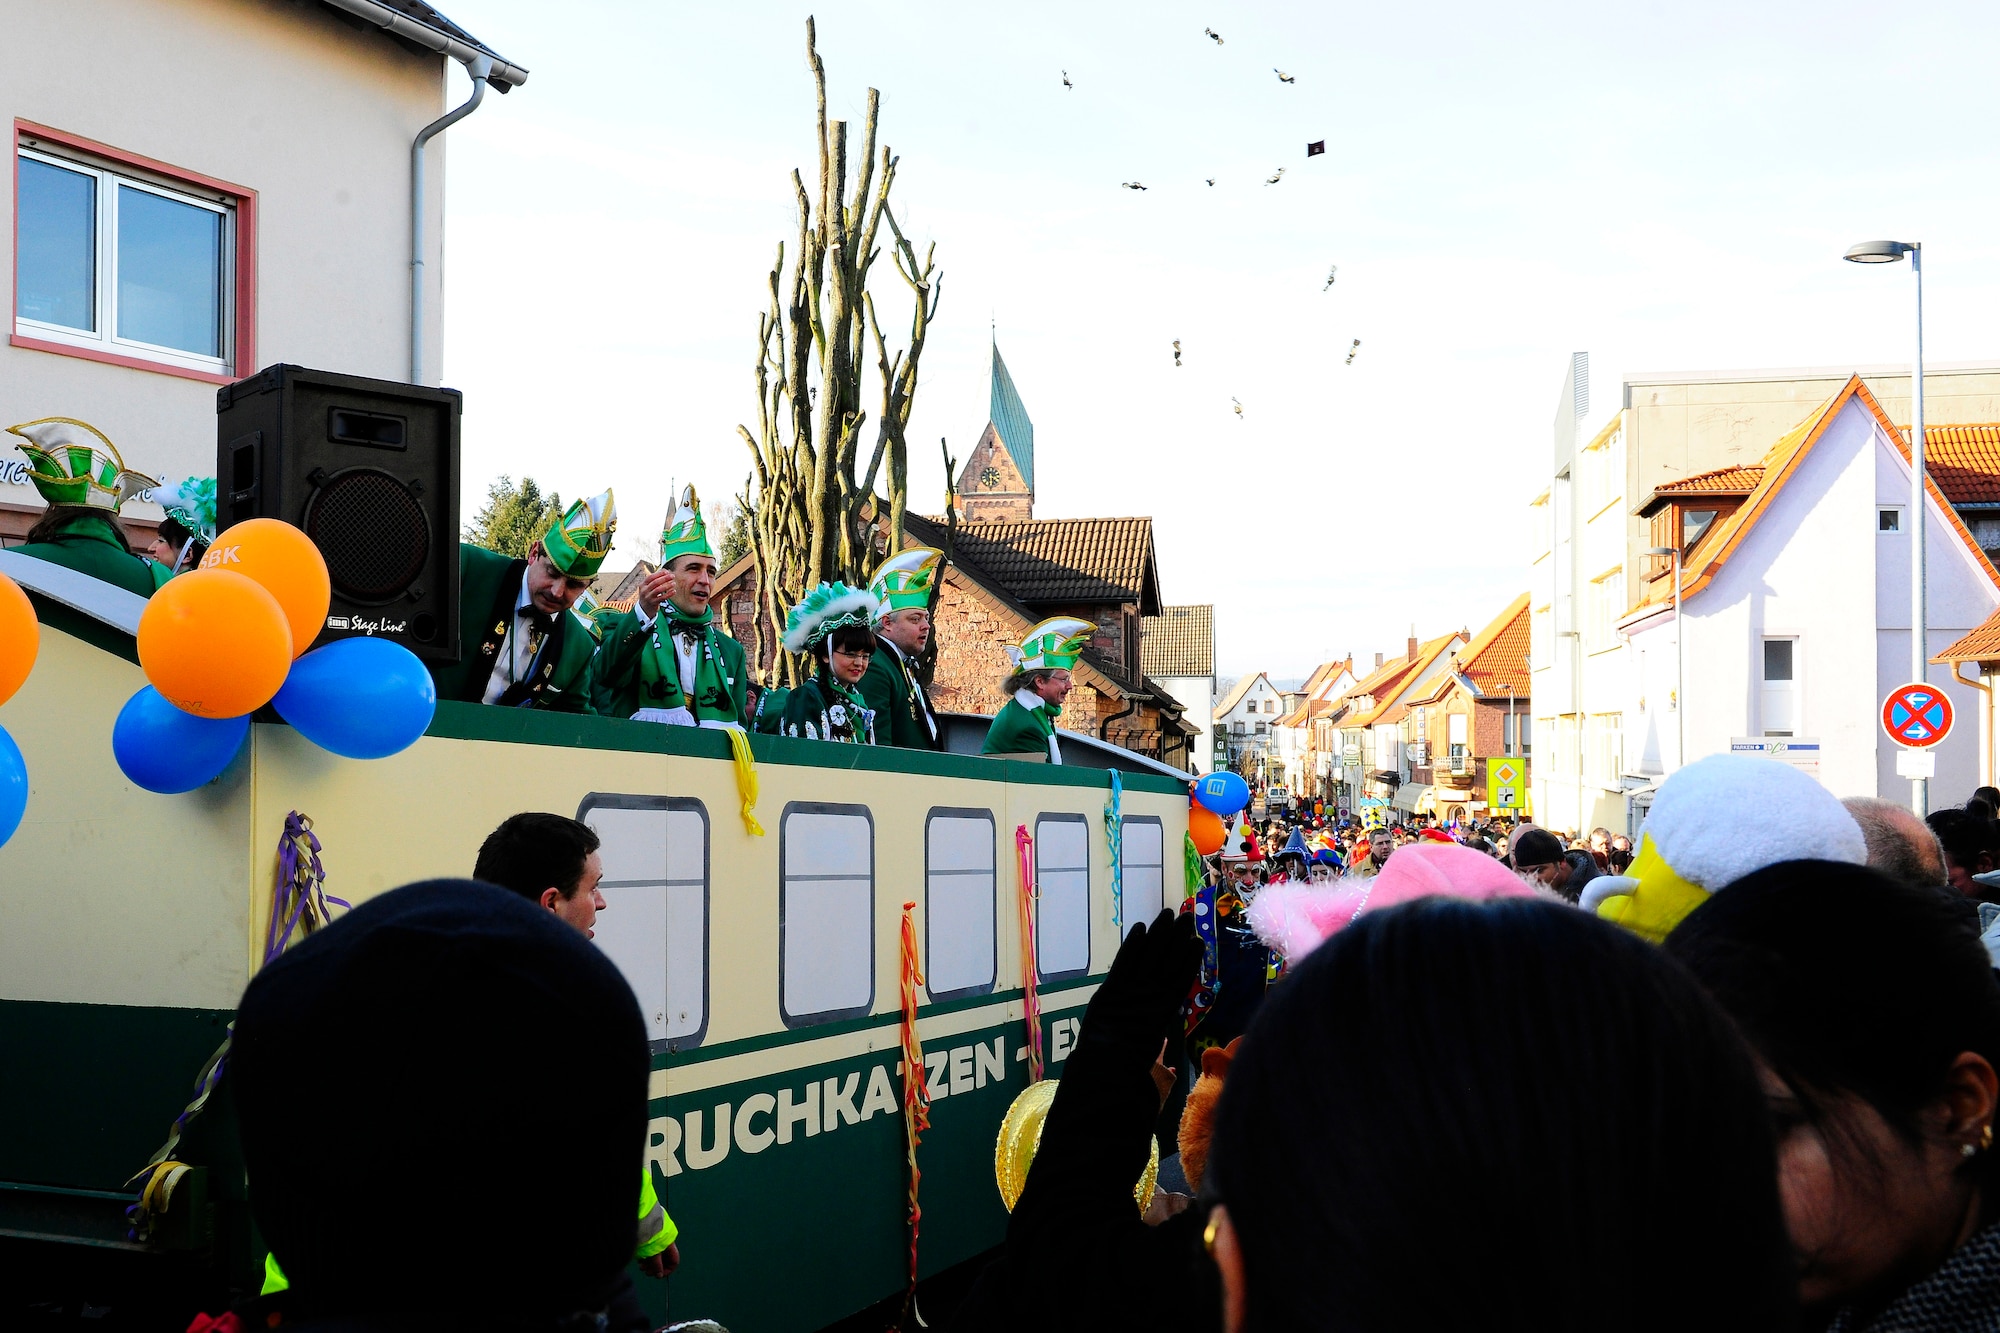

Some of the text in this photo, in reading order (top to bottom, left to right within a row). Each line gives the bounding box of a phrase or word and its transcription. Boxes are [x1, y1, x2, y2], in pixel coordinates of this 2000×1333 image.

[351, 615, 379, 635] Stage
[1216, 741, 1225, 750] GI
[1214, 752, 1228, 761] BILL
[644, 1035, 1006, 1177] RUCHKAZEN
